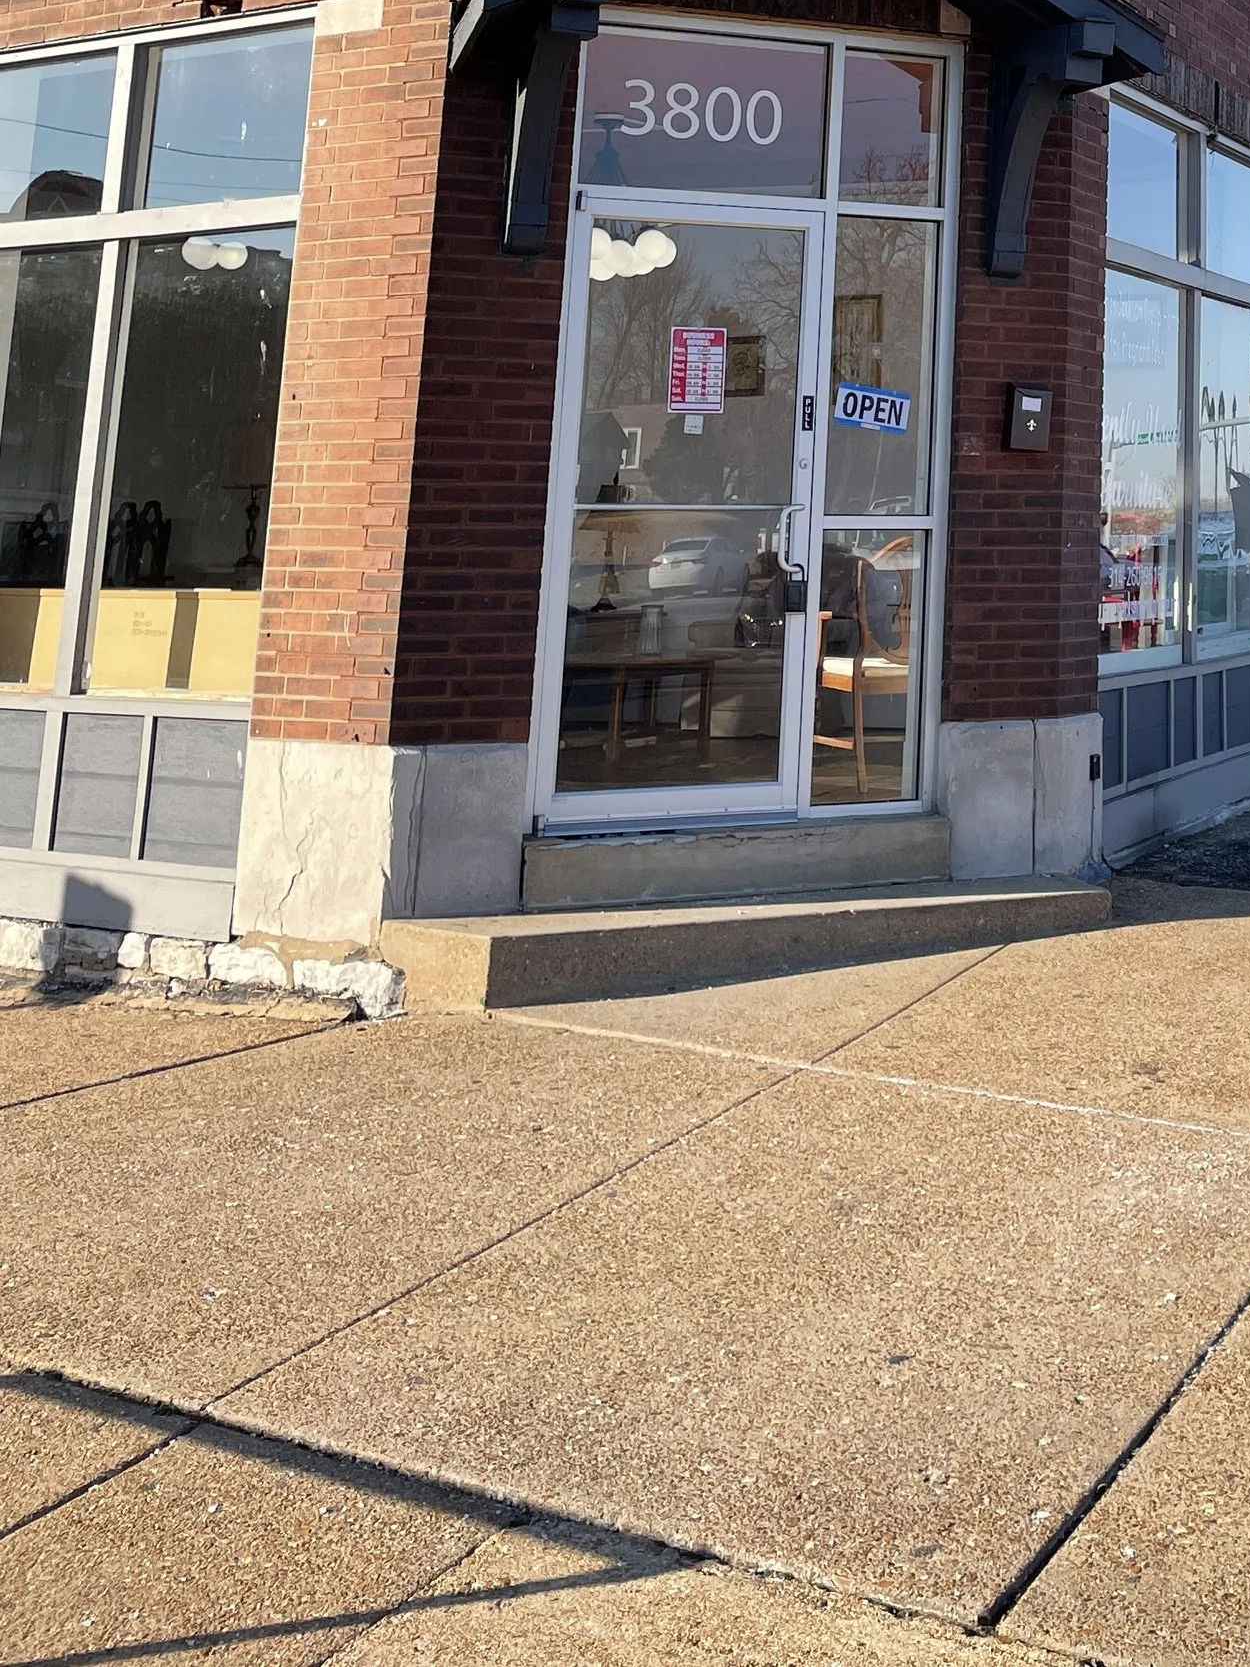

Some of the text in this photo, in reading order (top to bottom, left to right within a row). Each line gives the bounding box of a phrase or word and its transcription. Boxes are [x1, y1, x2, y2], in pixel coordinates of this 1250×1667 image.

[620, 79, 783, 145] 3800
[804, 398, 812, 429] PULL
[843, 392, 904, 426] OPEN
[1102, 401, 1141, 458] ently
